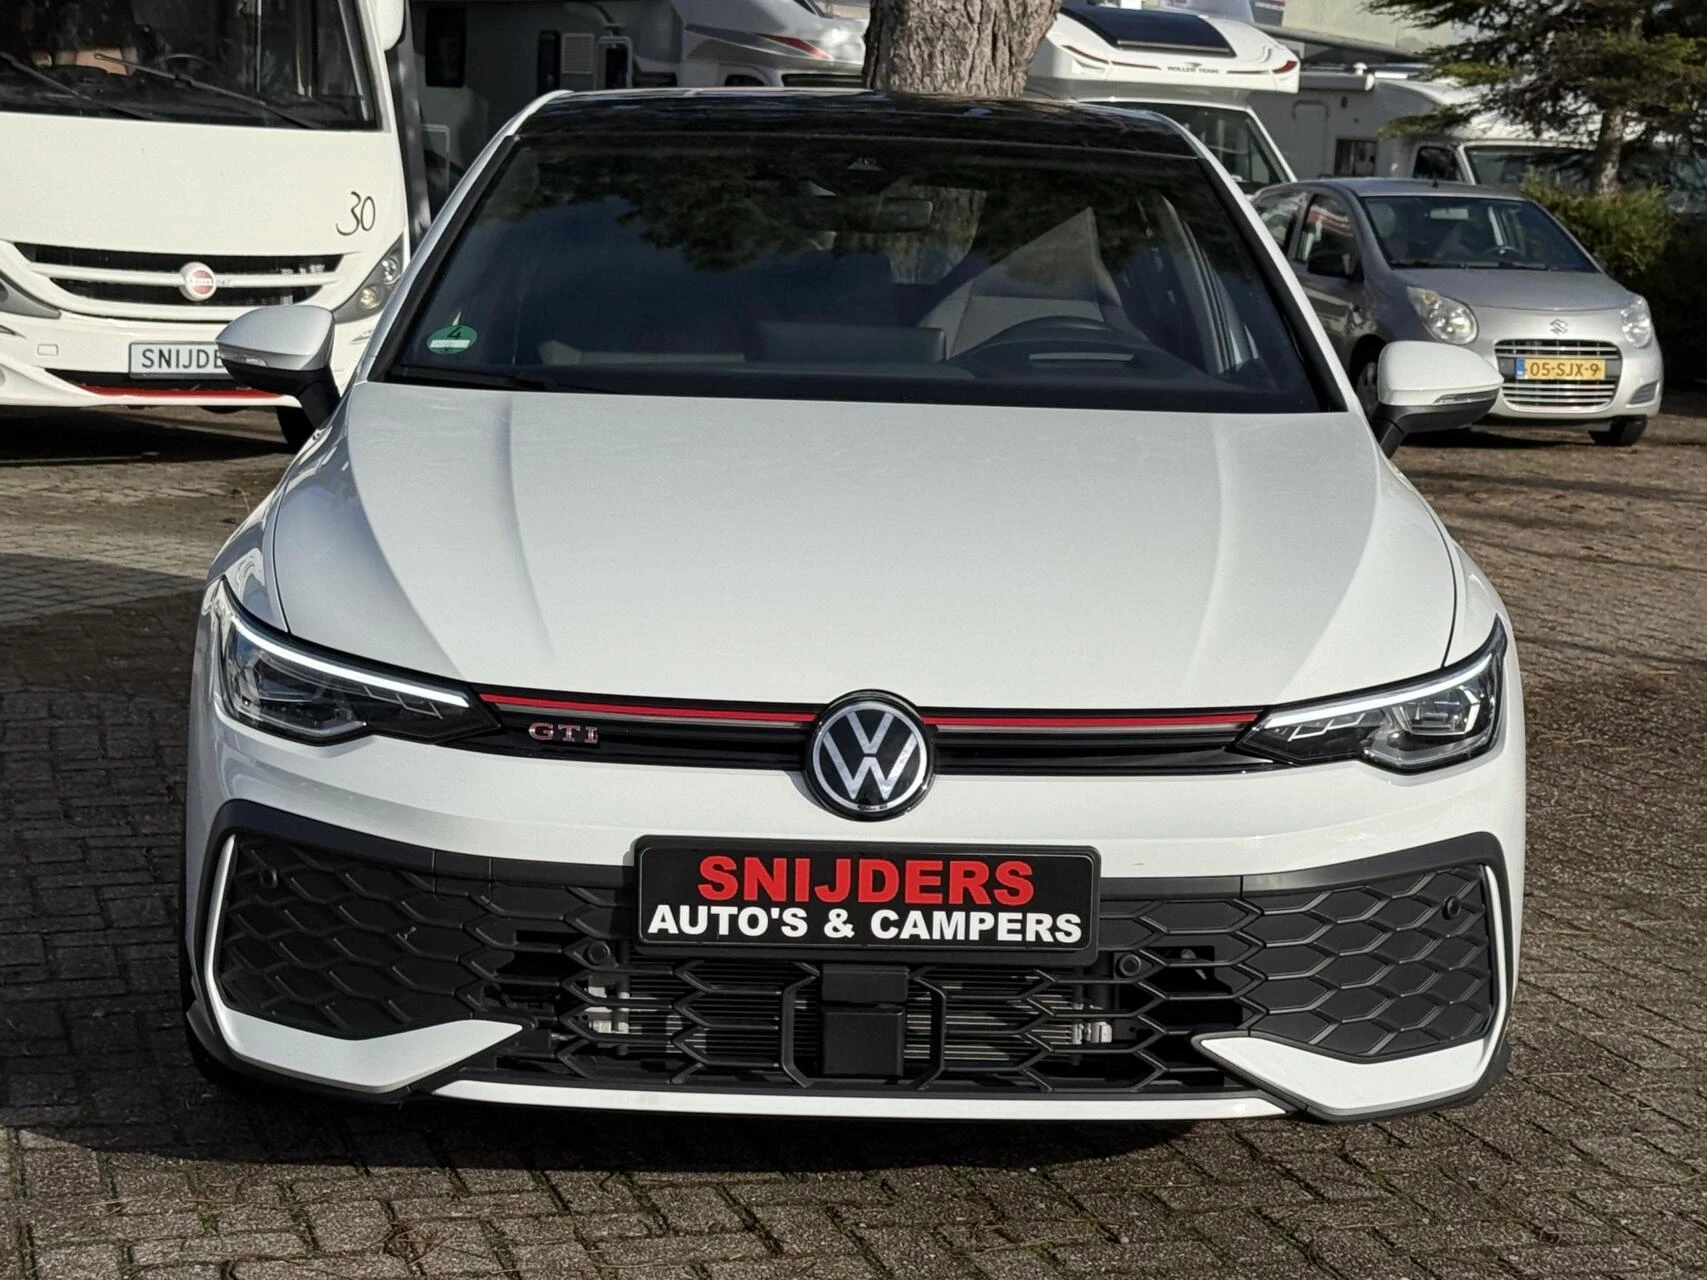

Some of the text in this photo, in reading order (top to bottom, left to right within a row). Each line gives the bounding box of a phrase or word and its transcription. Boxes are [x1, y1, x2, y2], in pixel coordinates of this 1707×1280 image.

[336, 191, 375, 236] 30
[447, 326, 462, 340] 4
[1530, 362, 1600, 377] 05-SJX-9
[528, 722, 598, 744] GTI
[820, 709, 920, 801] VW
[698, 855, 1035, 906] SNIJDERS
[647, 904, 1082, 943] AUTO'S & CAMPERS
